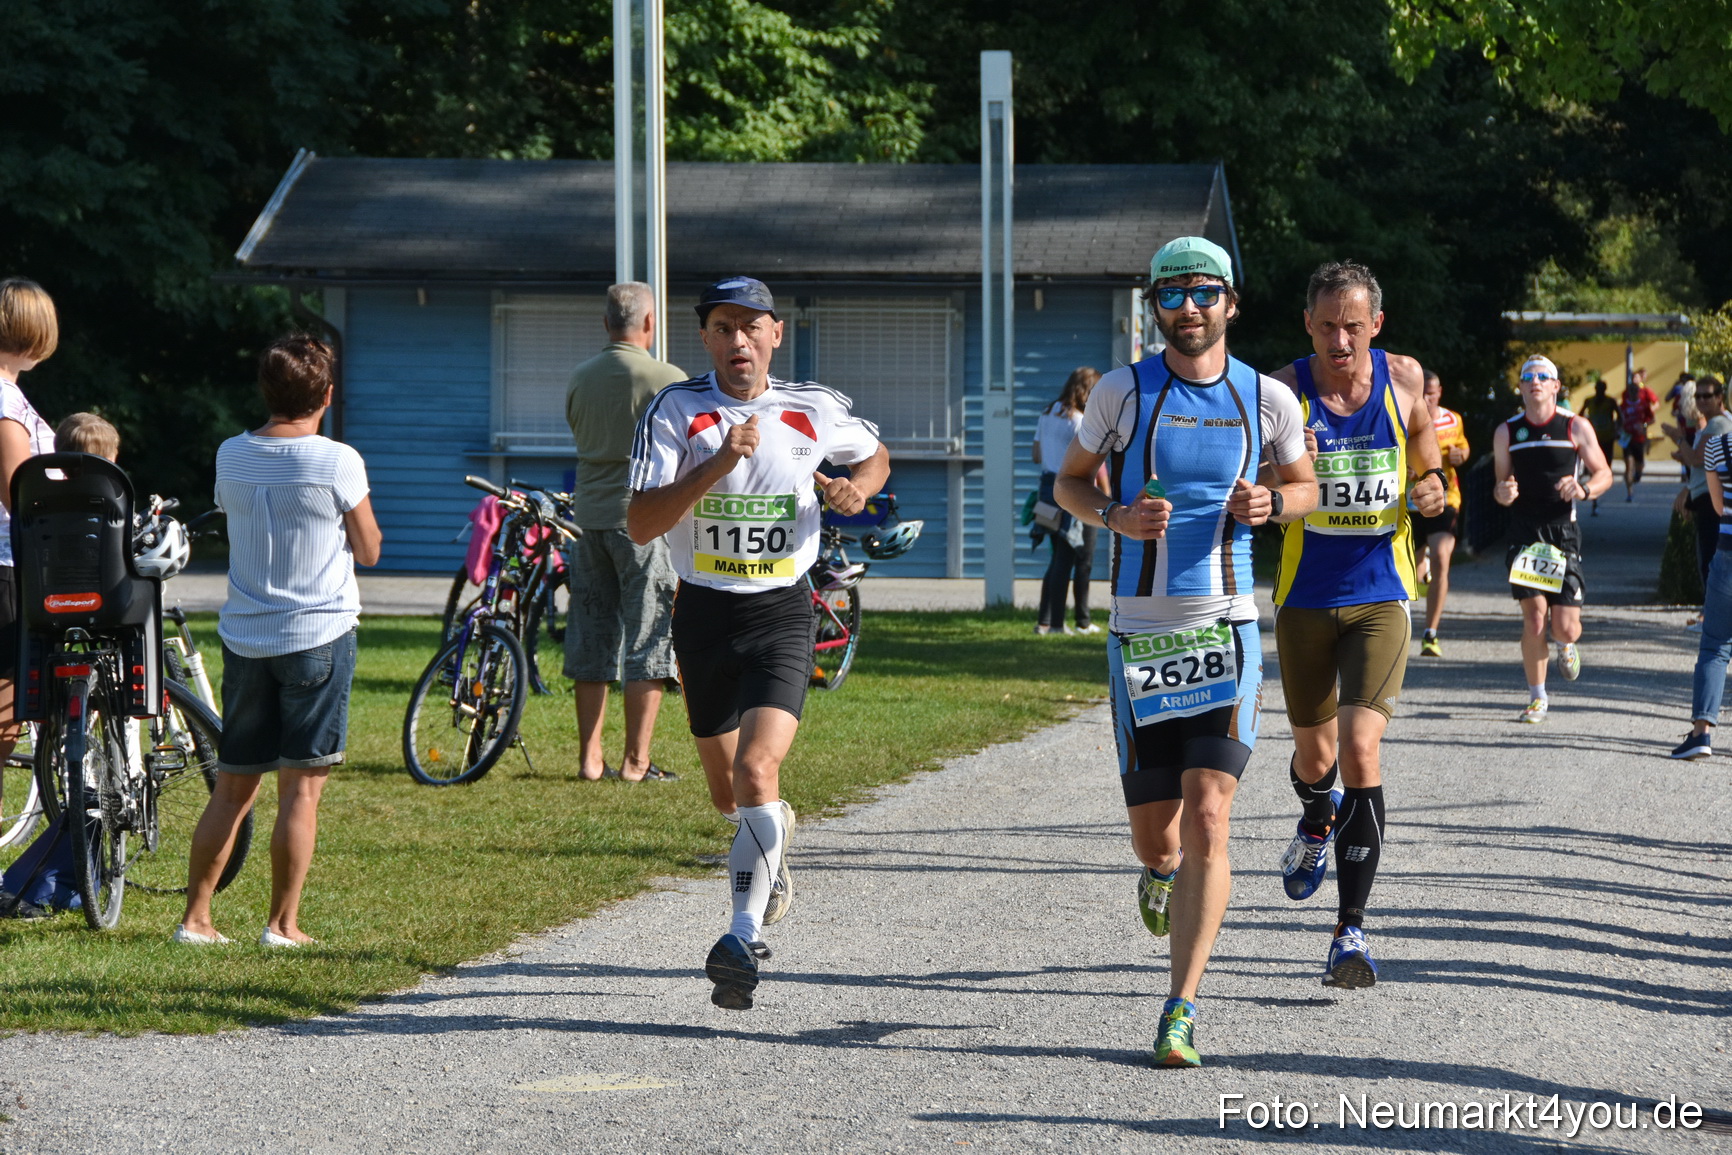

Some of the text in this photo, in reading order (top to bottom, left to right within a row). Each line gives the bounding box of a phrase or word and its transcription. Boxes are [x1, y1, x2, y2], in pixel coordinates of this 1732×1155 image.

[1160, 261, 1207, 273] Bianchi
[1332, 435, 1375, 444] INTERSPORT
[1314, 453, 1390, 473] BOCK
[1319, 480, 1390, 508] 1344
[702, 497, 788, 517] BOCK
[1328, 515, 1378, 526] MARIO
[706, 525, 787, 554] 1150
[714, 560, 774, 575] MARTIN
[1521, 556, 1559, 576] 1127
[1520, 573, 1553, 585] FLORIAN
[1130, 626, 1223, 659] BOCK
[1138, 651, 1226, 693] 2628
[1160, 689, 1211, 709] ARMIN
